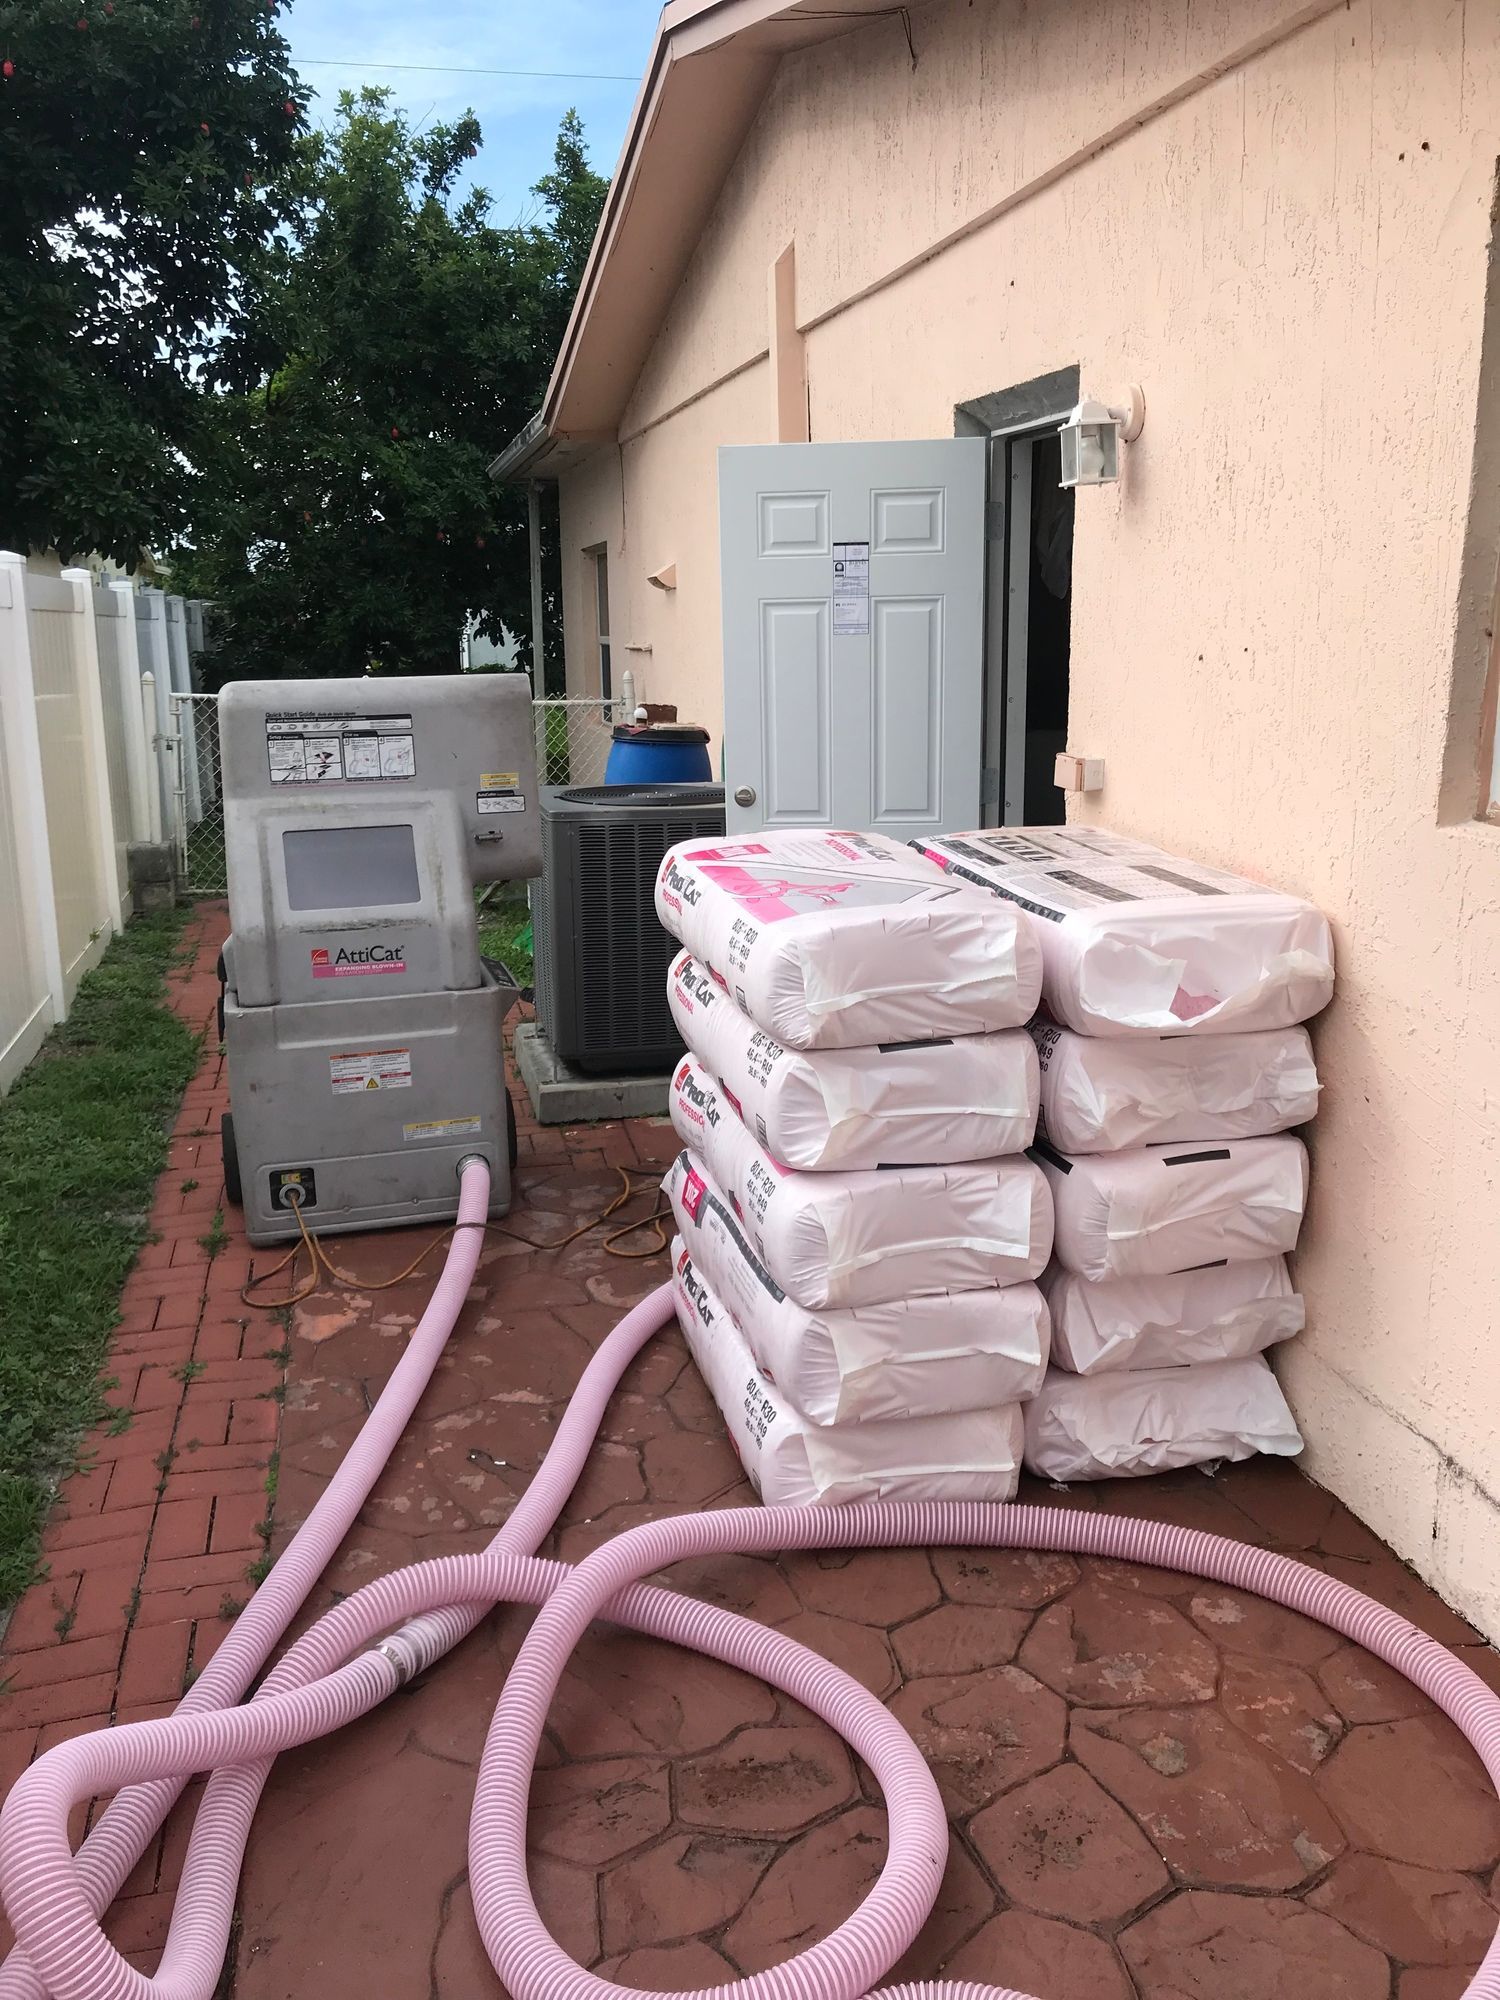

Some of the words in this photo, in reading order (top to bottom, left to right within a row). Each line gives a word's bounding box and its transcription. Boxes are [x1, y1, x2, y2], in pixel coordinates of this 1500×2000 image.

[744, 928, 758, 945] R30
[335, 945, 403, 964] AttiCat
[766, 1041, 784, 1060] R30
[761, 1059, 773, 1075] R49
[762, 1177, 776, 1197] R30
[758, 1194, 768, 1212] R49
[761, 1400, 777, 1424] R30
[757, 1417, 768, 1437] R49
